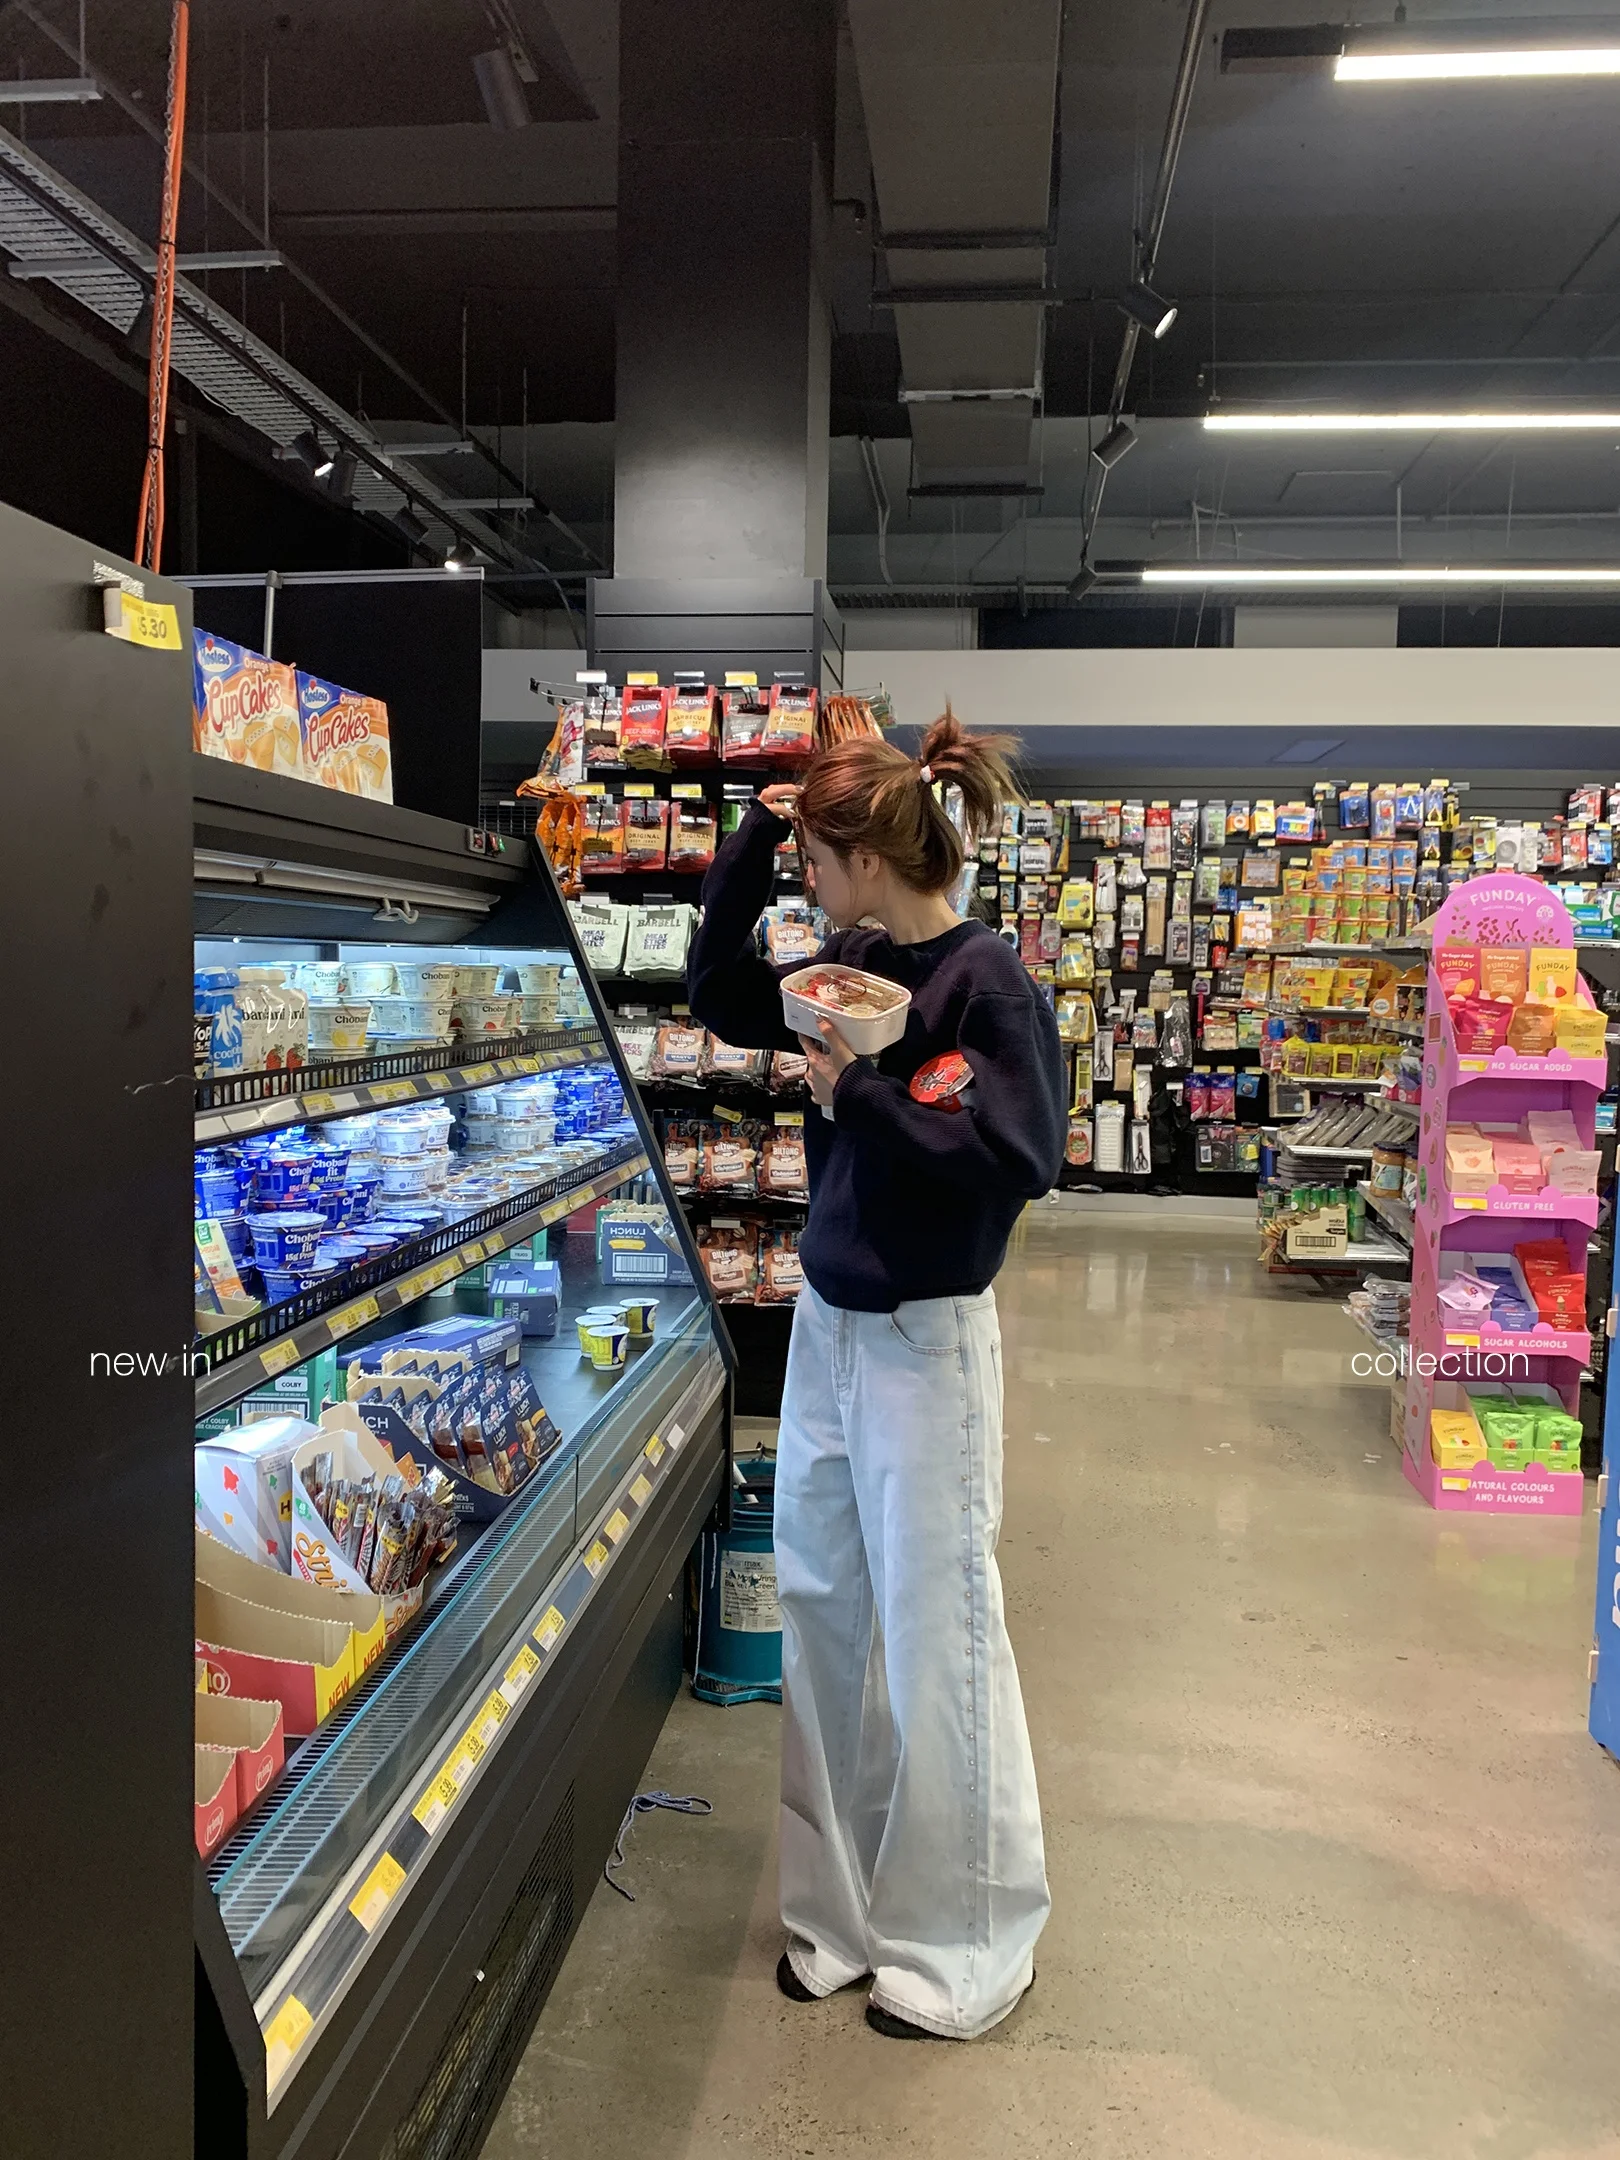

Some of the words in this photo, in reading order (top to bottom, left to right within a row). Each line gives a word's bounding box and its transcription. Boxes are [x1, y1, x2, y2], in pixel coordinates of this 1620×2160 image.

[244, 657, 270, 672] Orange
[340, 694, 362, 706] Orange
[1470, 890, 1537, 906] FUNDAY
[637, 918, 681, 927] BARBELL
[1440, 960, 1475, 970] FUNDAY
[1486, 962, 1520, 971] FUNDAY
[1535, 963, 1570, 972] FUNDAY
[669, 1033, 696, 1042] BILTONG
[1491, 1062, 1505, 1071] NO
[1509, 1063, 1539, 1072] SUGAR
[1544, 1063, 1572, 1072] ADDED
[714, 1142, 740, 1152] BILTONG
[773, 1147, 799, 1155] BILTONG
[327, 1167, 339, 1177] fit
[1493, 1202, 1530, 1211] GLUTEN
[1534, 1202, 1554, 1212] FREE
[302, 1242, 313, 1252] fit
[712, 1249, 738, 1260] BILTONG
[1484, 1338, 1515, 1348] SUGAR
[1518, 1338, 1568, 1349] ALCOHOLS
[281, 1381, 302, 1389] COLBY
[1511, 1483, 1555, 1492] COLOURS
[1475, 1494, 1493, 1502] AND
[1497, 1495, 1545, 1504] FLAVOURS
[363, 1636, 385, 1671] NEW
[329, 1672, 350, 1711] NEW
